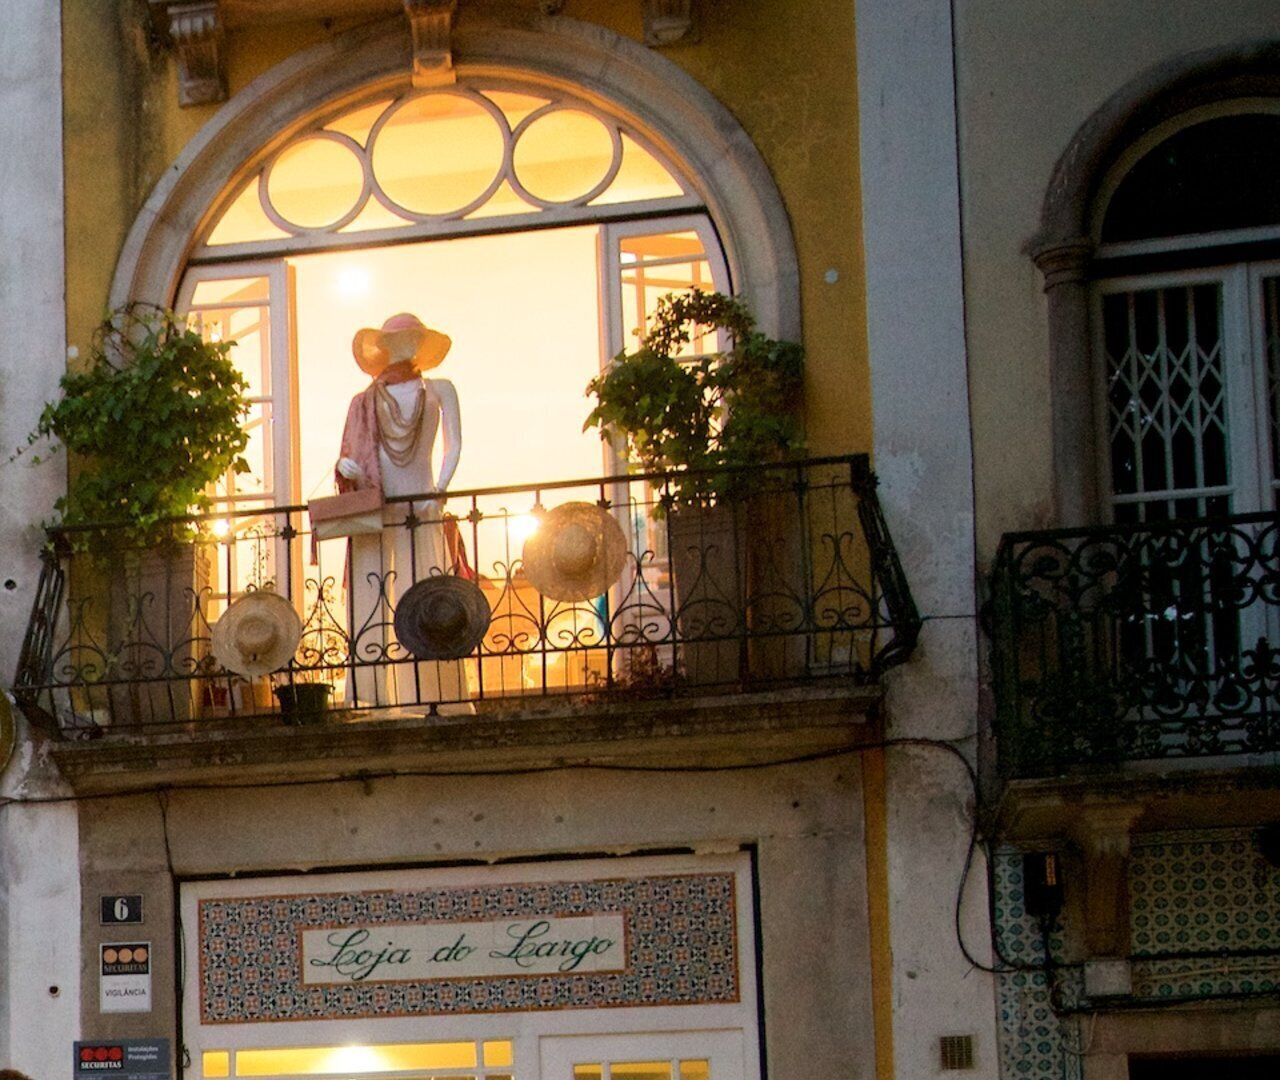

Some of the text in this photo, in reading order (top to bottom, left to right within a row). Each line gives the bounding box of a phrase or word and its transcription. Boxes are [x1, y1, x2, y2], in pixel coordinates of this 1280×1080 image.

[114, 898, 129, 921] 6
[310, 921, 616, 981] Loja do Largo
[104, 963, 147, 974] SECURITAS
[105, 985, 147, 998] VIGILÂNCIA
[81, 1061, 122, 1069] SECURITAS
